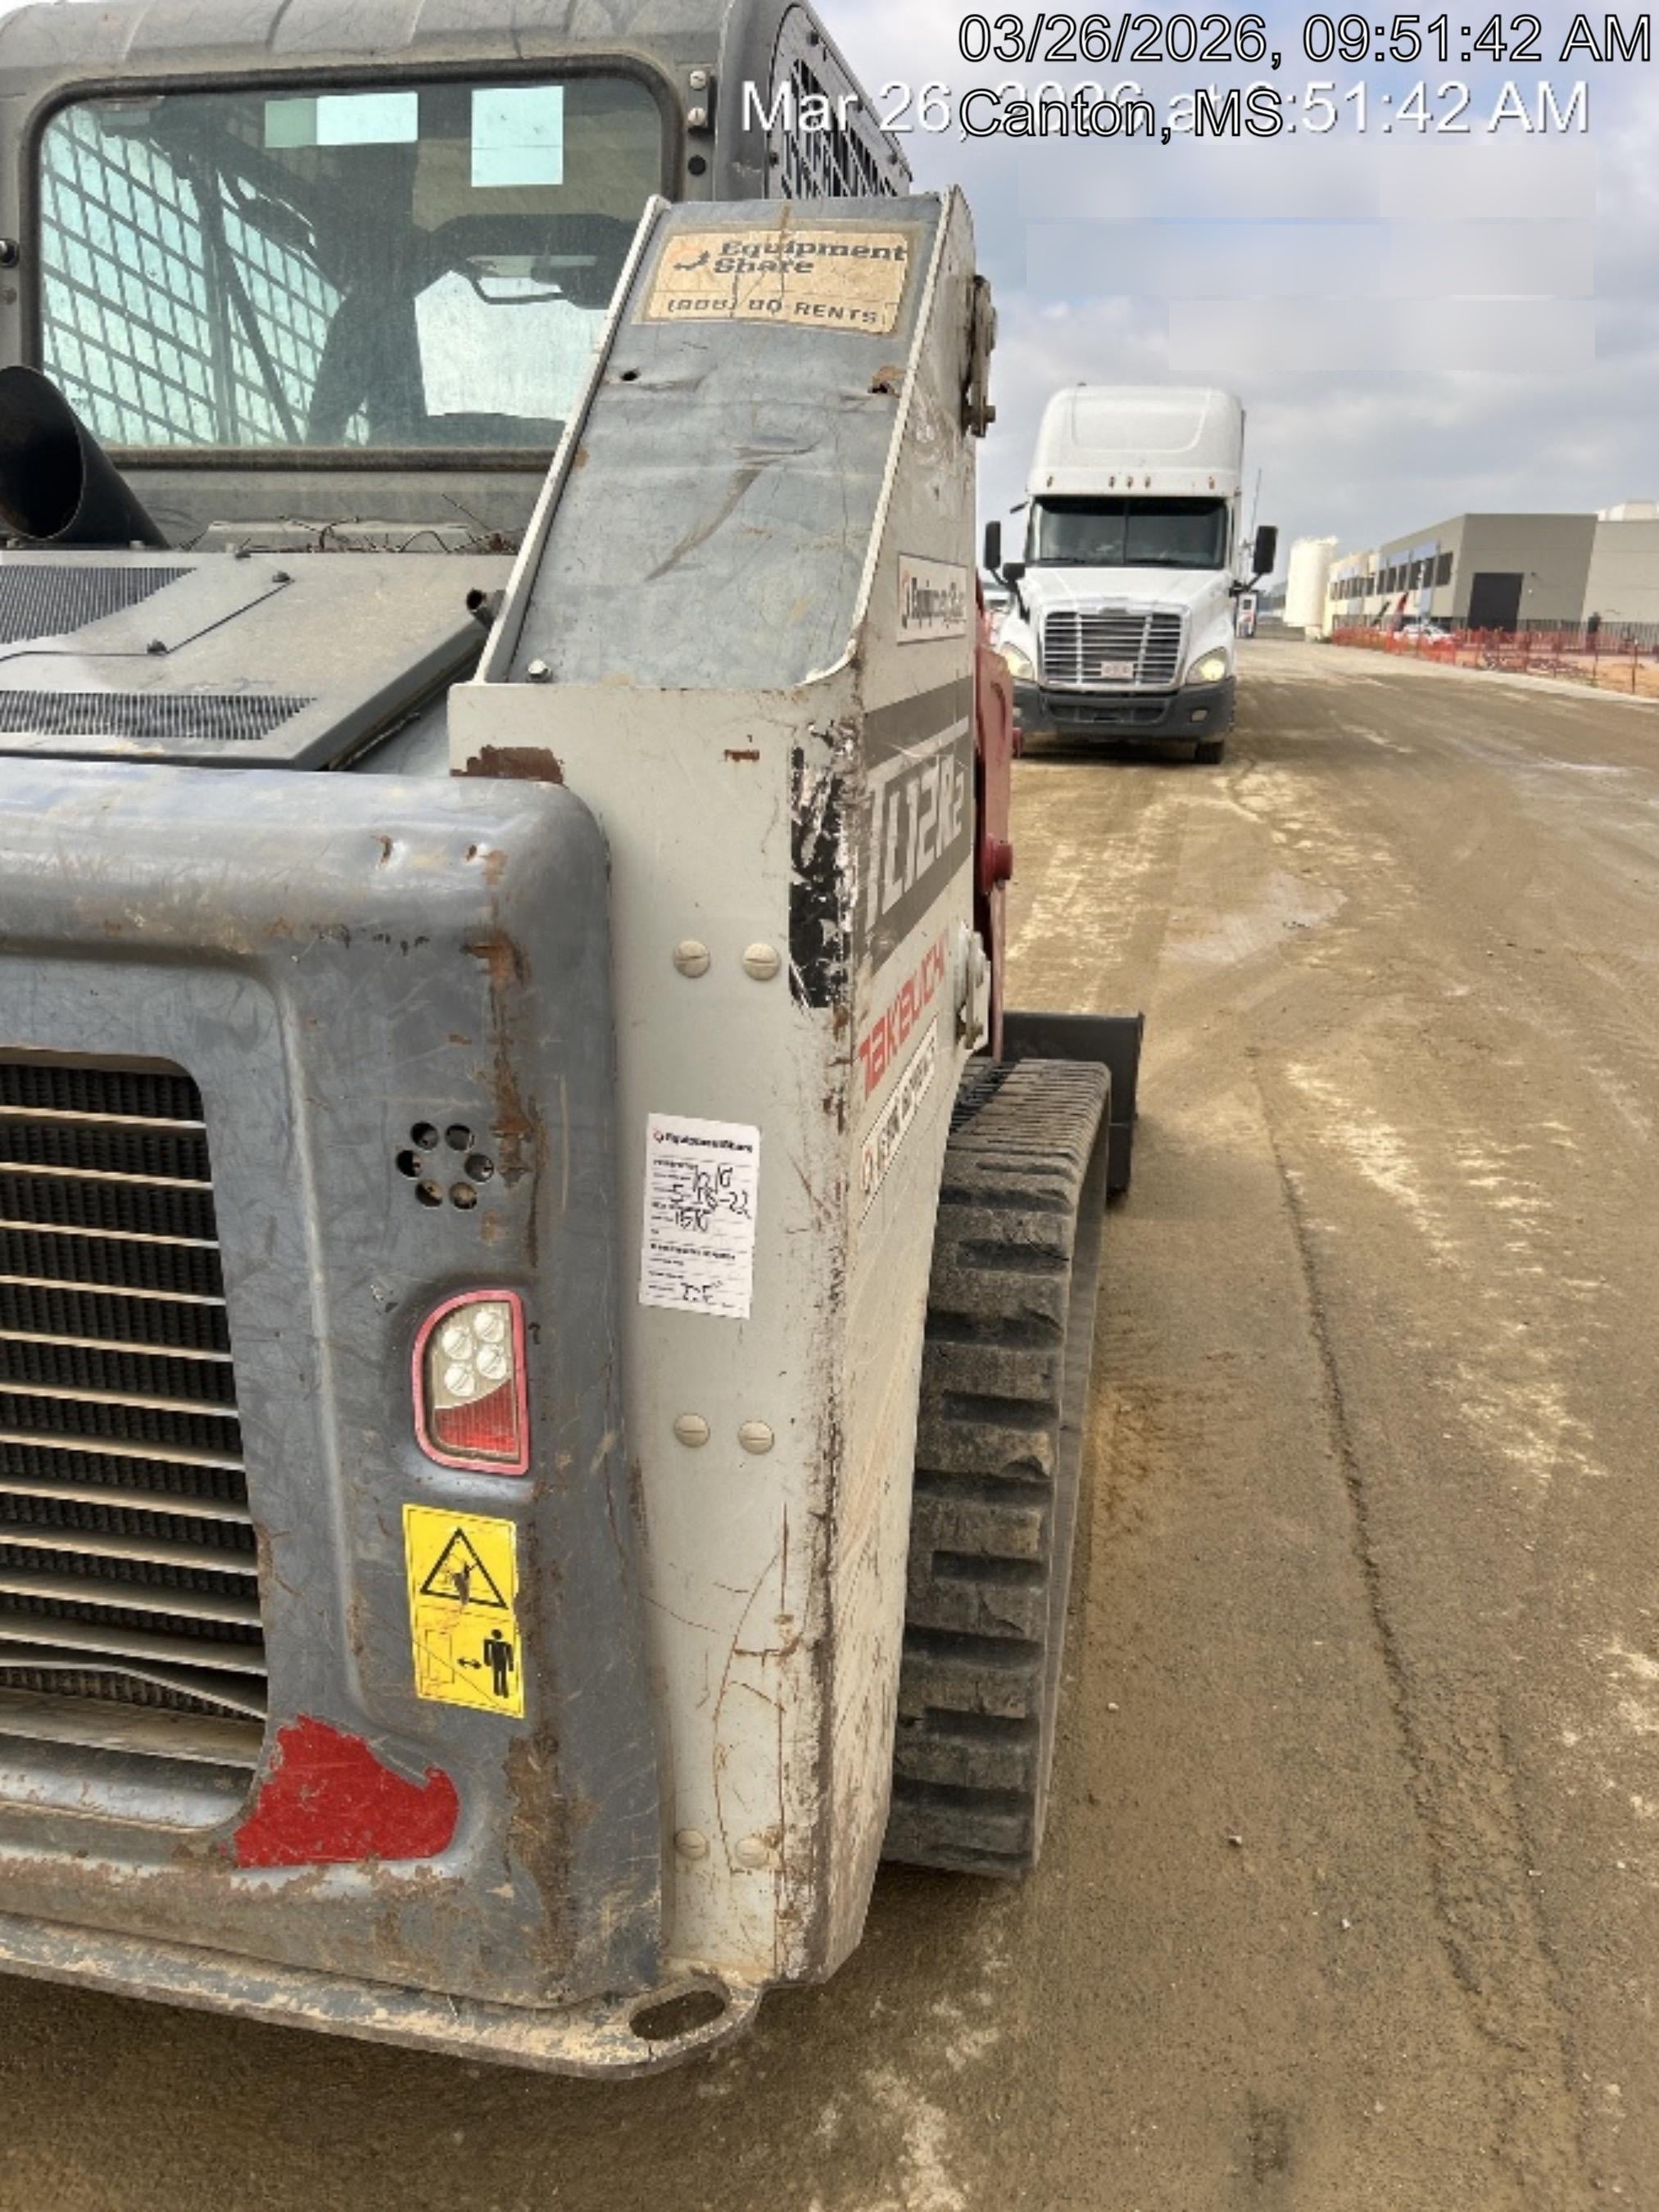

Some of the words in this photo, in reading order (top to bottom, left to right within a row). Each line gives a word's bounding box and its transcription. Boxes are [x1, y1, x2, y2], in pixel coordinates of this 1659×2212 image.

[719, 240, 908, 261] Equipment
[714, 257, 814, 274] Share
[794, 302, 877, 324] RENTS
